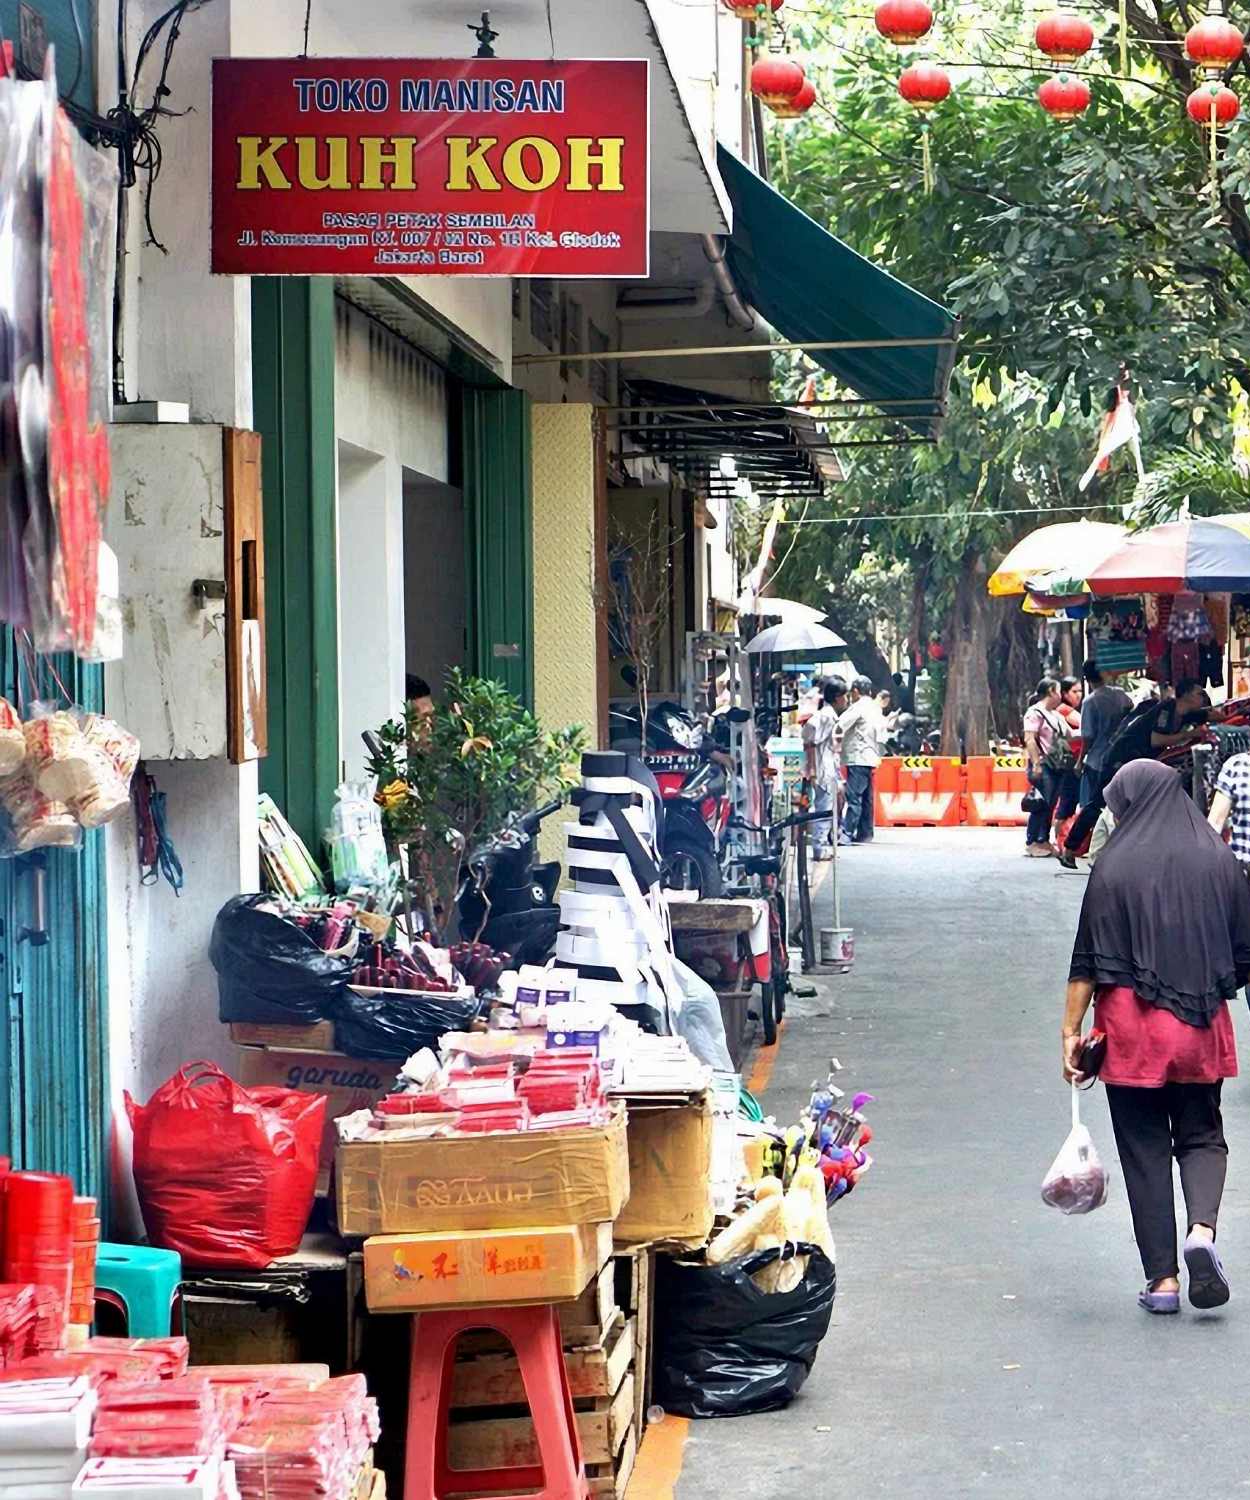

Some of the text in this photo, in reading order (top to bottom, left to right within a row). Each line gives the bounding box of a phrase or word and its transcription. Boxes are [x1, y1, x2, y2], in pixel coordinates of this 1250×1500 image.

[293, 78, 565, 113] TOKO MANISAN
[236, 135, 626, 192] KUH KOH
[385, 212, 441, 228] PETAK
[446, 213, 536, 228] SEMBILAN
